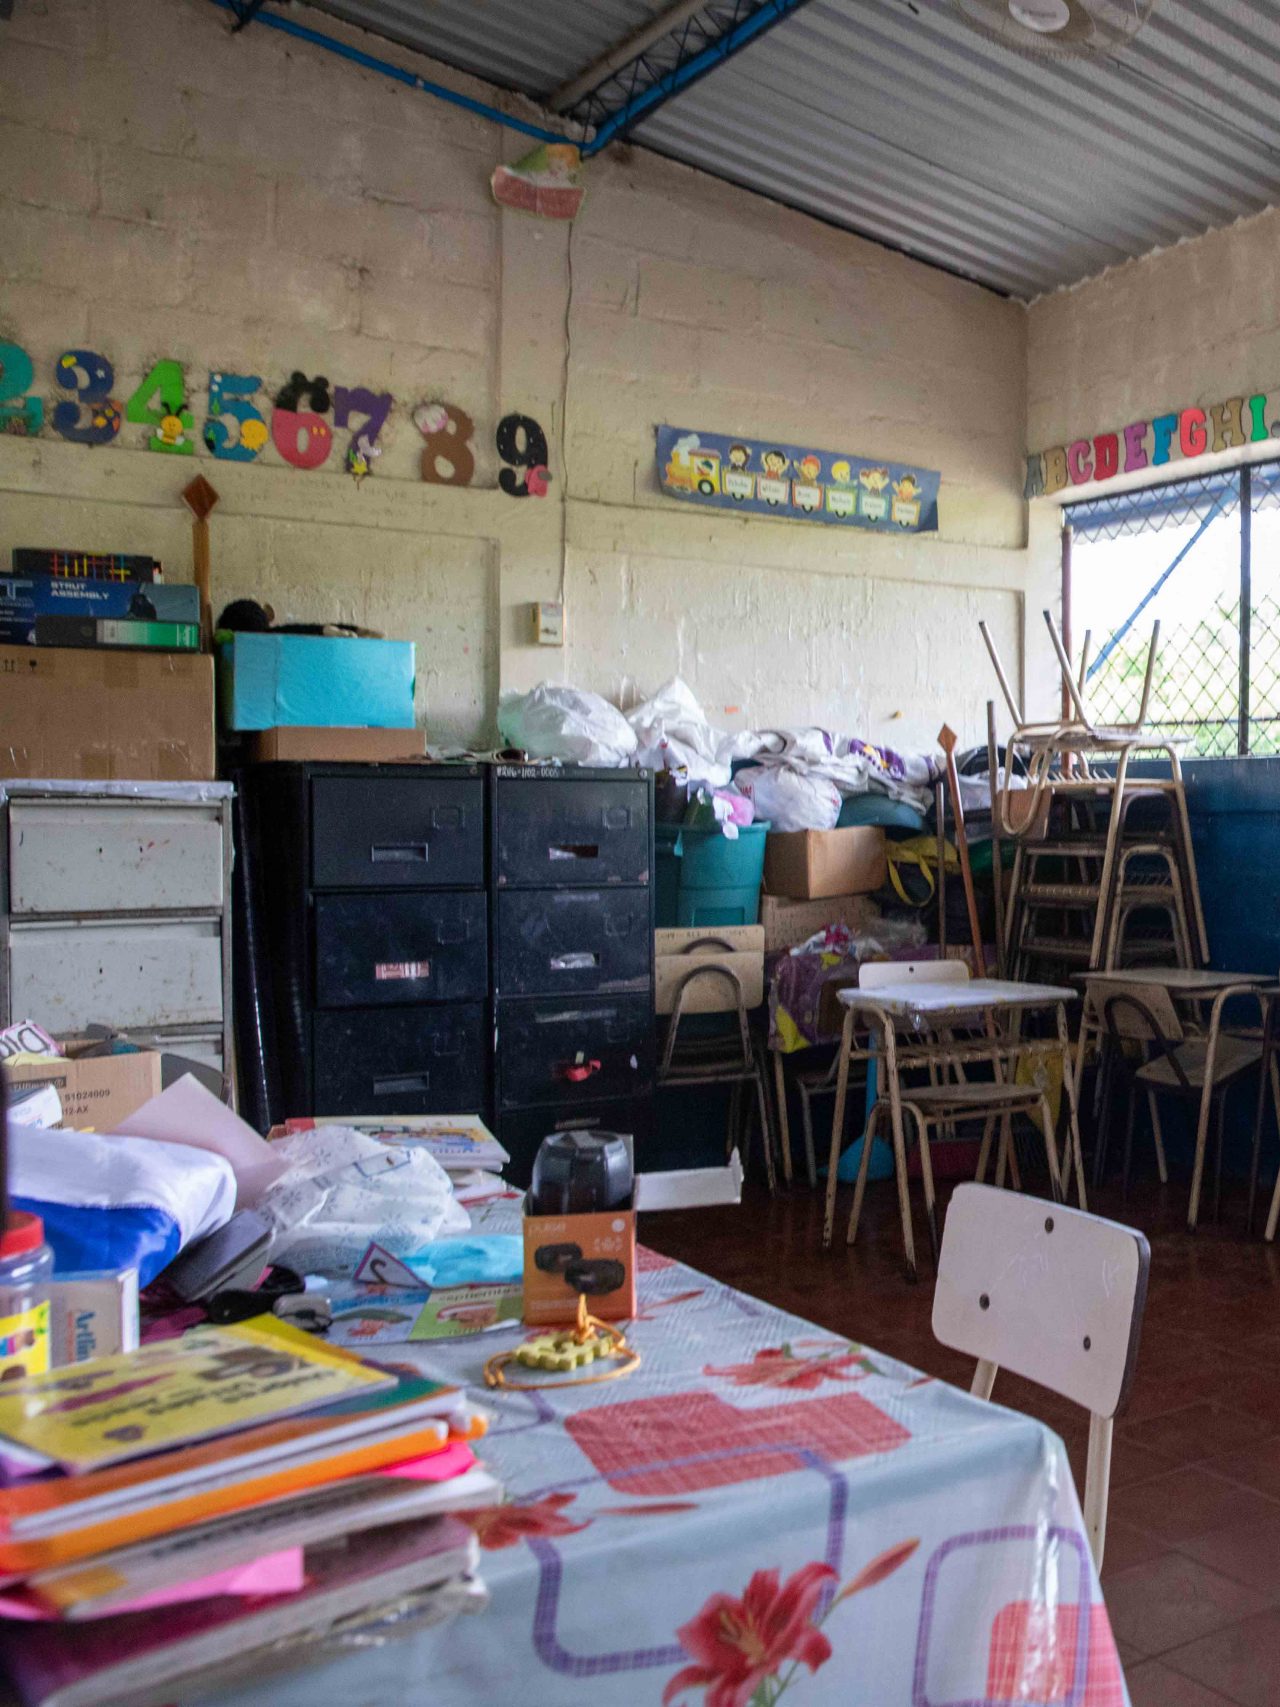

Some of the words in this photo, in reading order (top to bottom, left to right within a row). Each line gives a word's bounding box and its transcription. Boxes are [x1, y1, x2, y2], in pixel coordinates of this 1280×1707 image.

[0, 337, 44, 436] 2
[53, 350, 123, 444] 3
[127, 357, 194, 455] 4
[203, 372, 268, 462] 5
[272, 371, 332, 470] 6
[334, 385, 393, 475] 7
[411, 402, 474, 486] 8
[496, 413, 549, 497] 9
[1045, 446, 1068, 496] B
[1068, 440, 1092, 486] C
[1093, 433, 1119, 481] D
[1124, 421, 1148, 472] E
[1152, 413, 1177, 466] F
[1180, 407, 1207, 457] G
[1210, 397, 1246, 453] H
[1249, 394, 1269, 442] I
[50, 581, 87, 591] STRUT
[50, 589, 109, 600] ASSEMBLY
